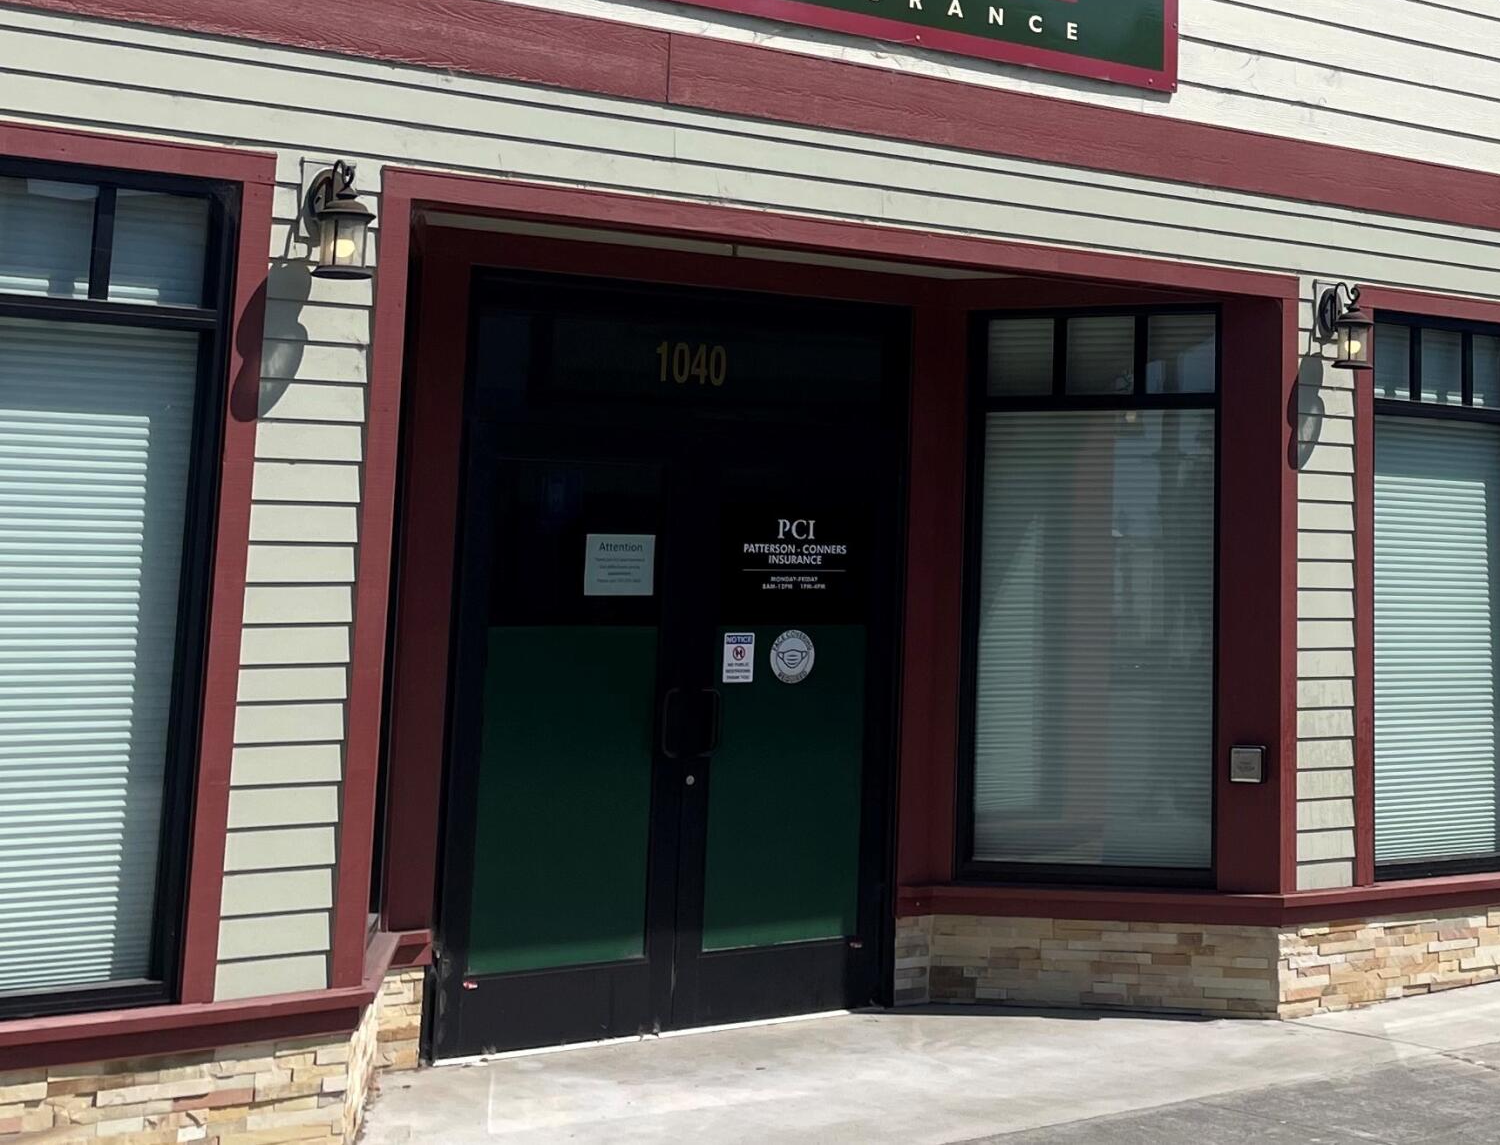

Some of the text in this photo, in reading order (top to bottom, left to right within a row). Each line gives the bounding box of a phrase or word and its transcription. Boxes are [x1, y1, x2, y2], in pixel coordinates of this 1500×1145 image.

[656, 341, 727, 387] 1040
[777, 518, 816, 540] PCI
[599, 541, 643, 552] Attention
[743, 543, 796, 554] PATTERSON
[802, 544, 847, 555] CONNERS
[768, 555, 822, 565] INSURANCE
[726, 635, 752, 643] NOTICE
